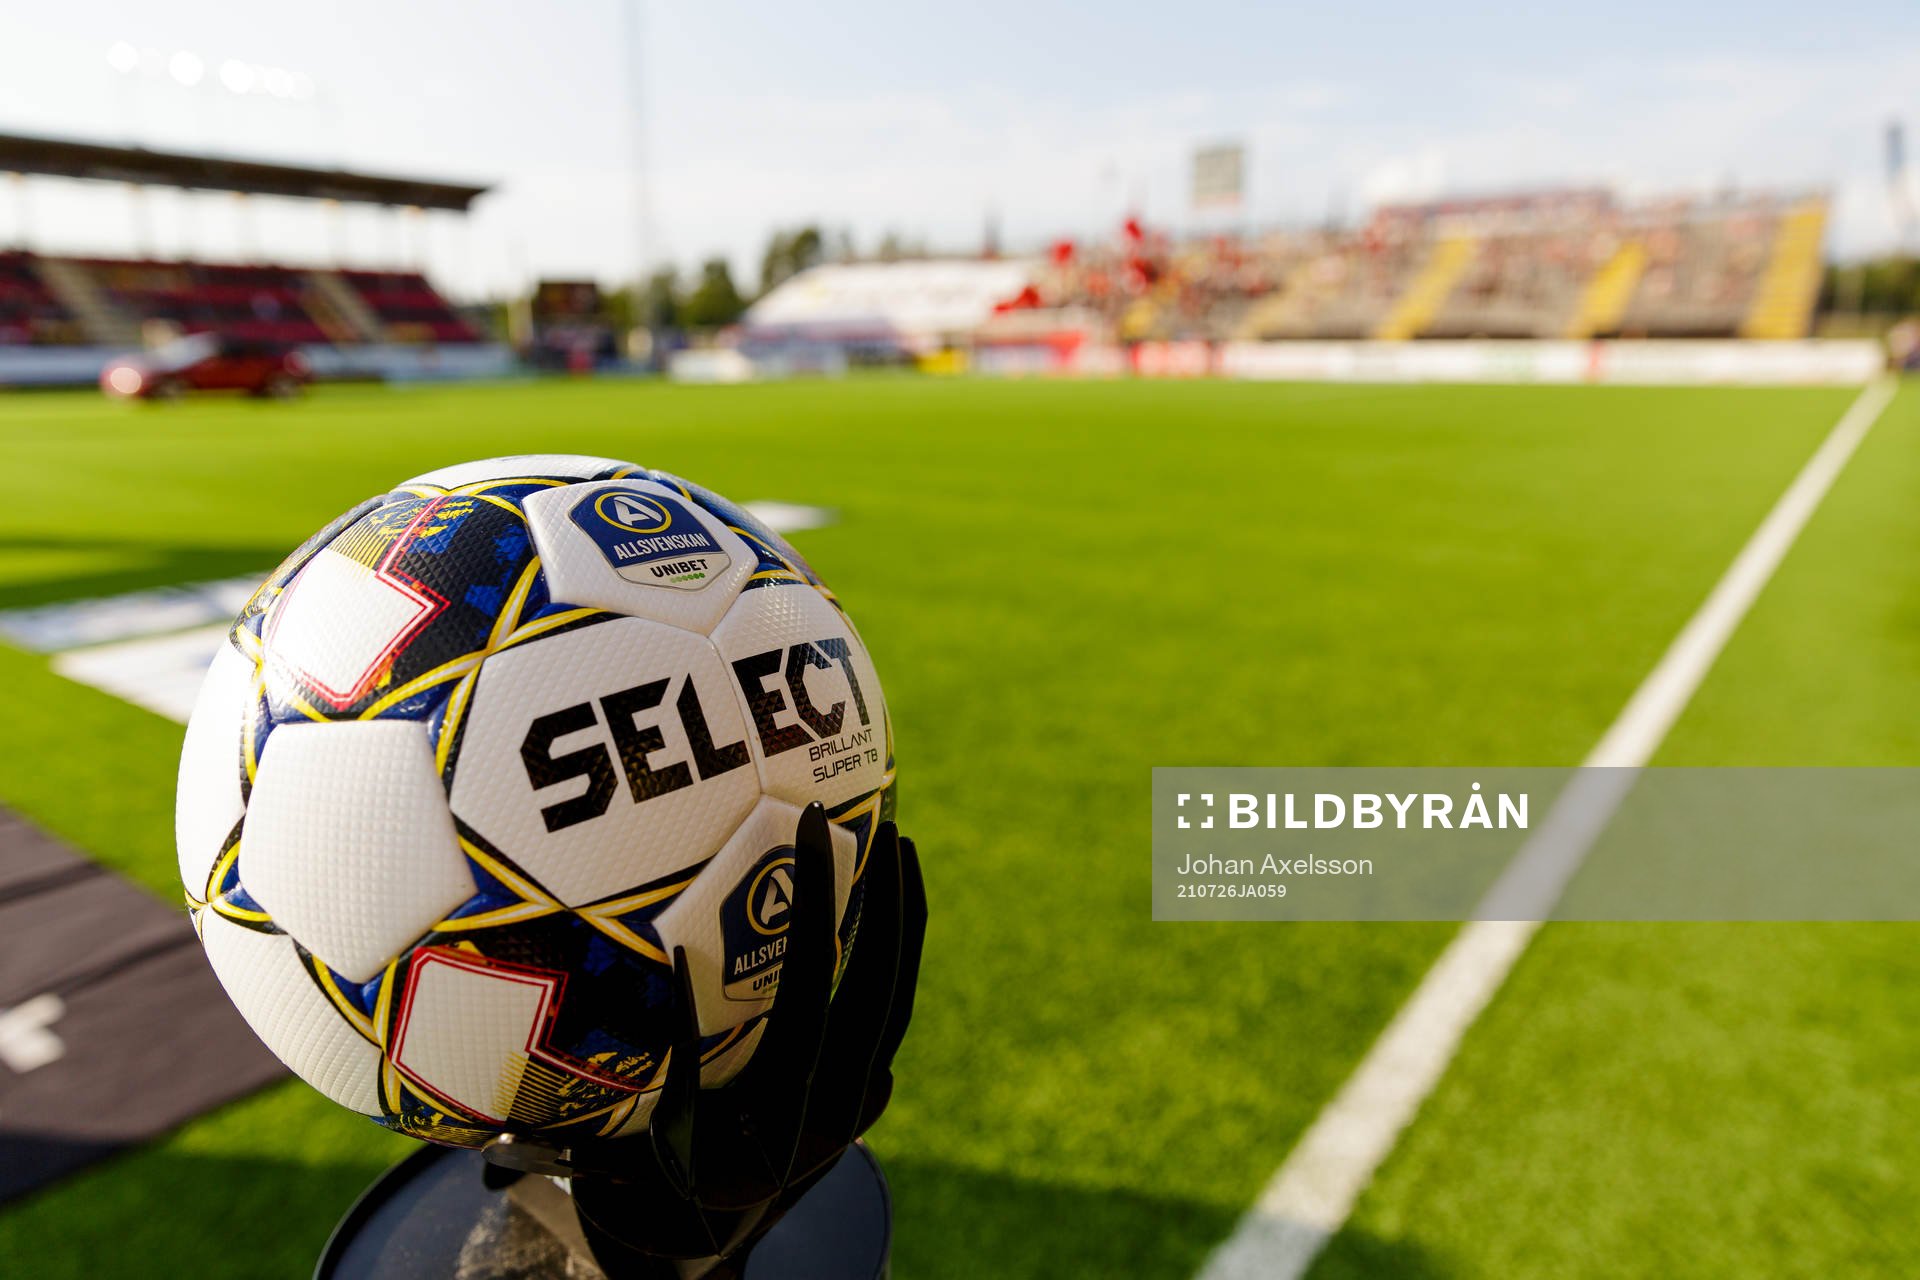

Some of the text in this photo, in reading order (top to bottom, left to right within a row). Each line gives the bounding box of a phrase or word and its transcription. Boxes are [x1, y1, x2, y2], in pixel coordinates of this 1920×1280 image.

[613, 533, 710, 560] ALLSVENSKAN
[650, 558, 709, 578] UNIBET
[520, 637, 870, 833] SELECT
[808, 728, 872, 762] BRILLANT
[813, 748, 879, 784] SUPER TB
[752, 970, 780, 991] UNI
